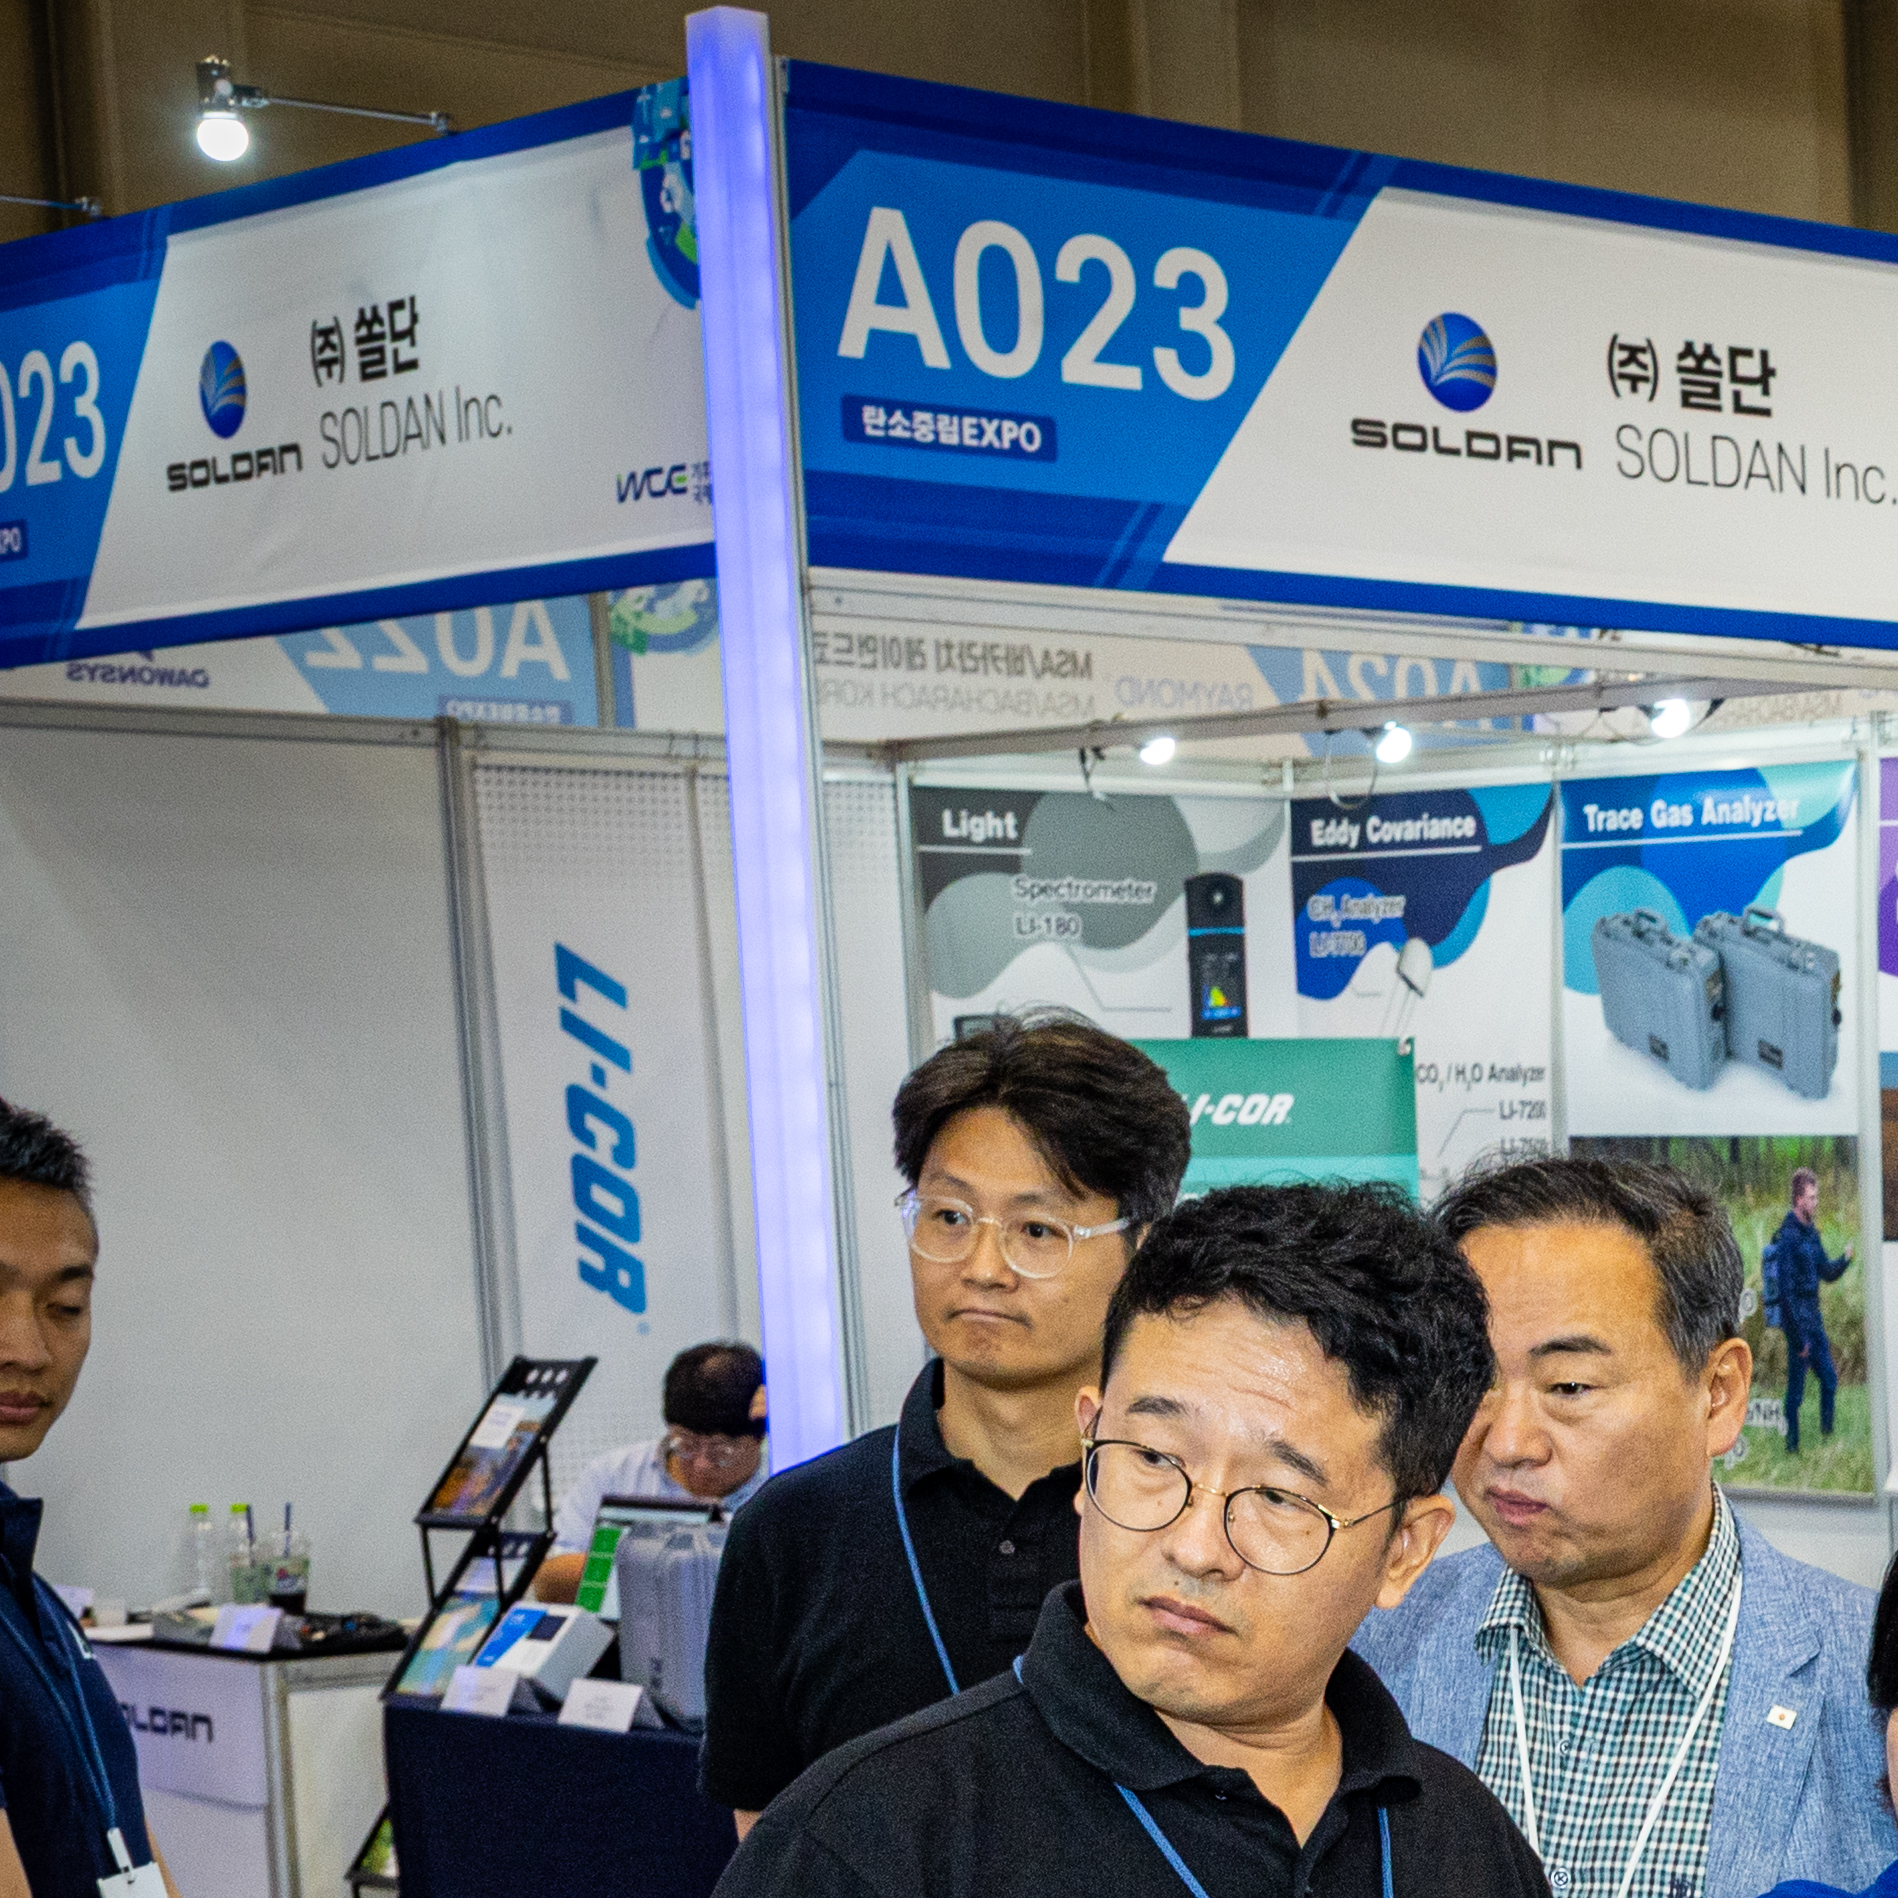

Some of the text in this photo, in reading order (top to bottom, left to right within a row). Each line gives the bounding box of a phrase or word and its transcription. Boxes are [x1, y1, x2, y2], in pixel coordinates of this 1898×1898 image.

[838, 206, 1236, 401] A023
[355, 295, 420, 383] 쏠단
[1676, 340, 1777, 418] 쏠단
[321, 385, 514, 470] SOLDAN Inc.
[861, 404, 1042, 453] 탄소중립EXPO
[1351, 418, 1584, 470] SOLDAN
[167, 441, 303, 492] SOLDAN
[617, 463, 688, 504] WCE
[1616, 425, 1898, 506] SOLDAN Inc.
[942, 809, 1018, 840] Light
[1311, 812, 1477, 847] Eddy Covariance
[1583, 794, 1801, 833] Trace Gas Analyzer
[1013, 874, 1155, 904] Spectrometer
[1488, 1062, 1546, 1087] Analyzer
[554, 941, 646, 1314] LI-COR
[1182, 1093, 1295, 1125] I-COR
